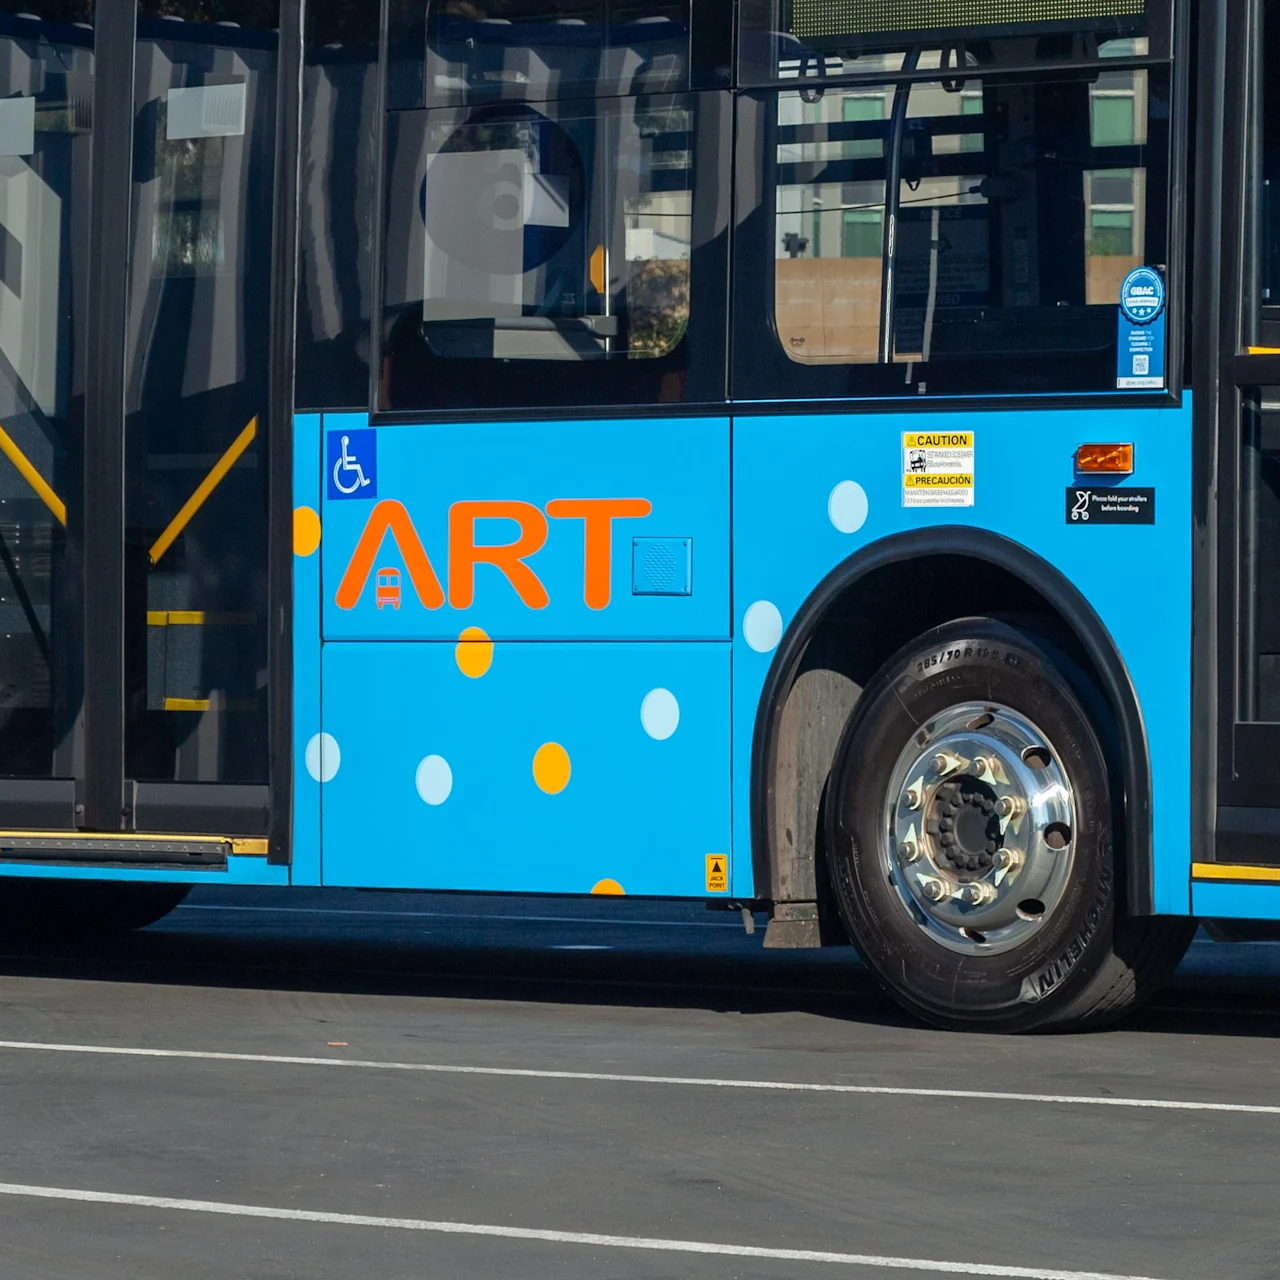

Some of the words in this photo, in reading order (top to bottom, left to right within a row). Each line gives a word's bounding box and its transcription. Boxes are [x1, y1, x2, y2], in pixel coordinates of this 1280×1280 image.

[1130, 286, 1154, 296] GBAC
[917, 435, 967, 446] CAUTION
[915, 474, 971, 485] PRECAUCIÓN
[1117, 504, 1139, 513] boarding
[335, 498, 652, 611] ART
[1037, 866, 1114, 995] MICHELIN
